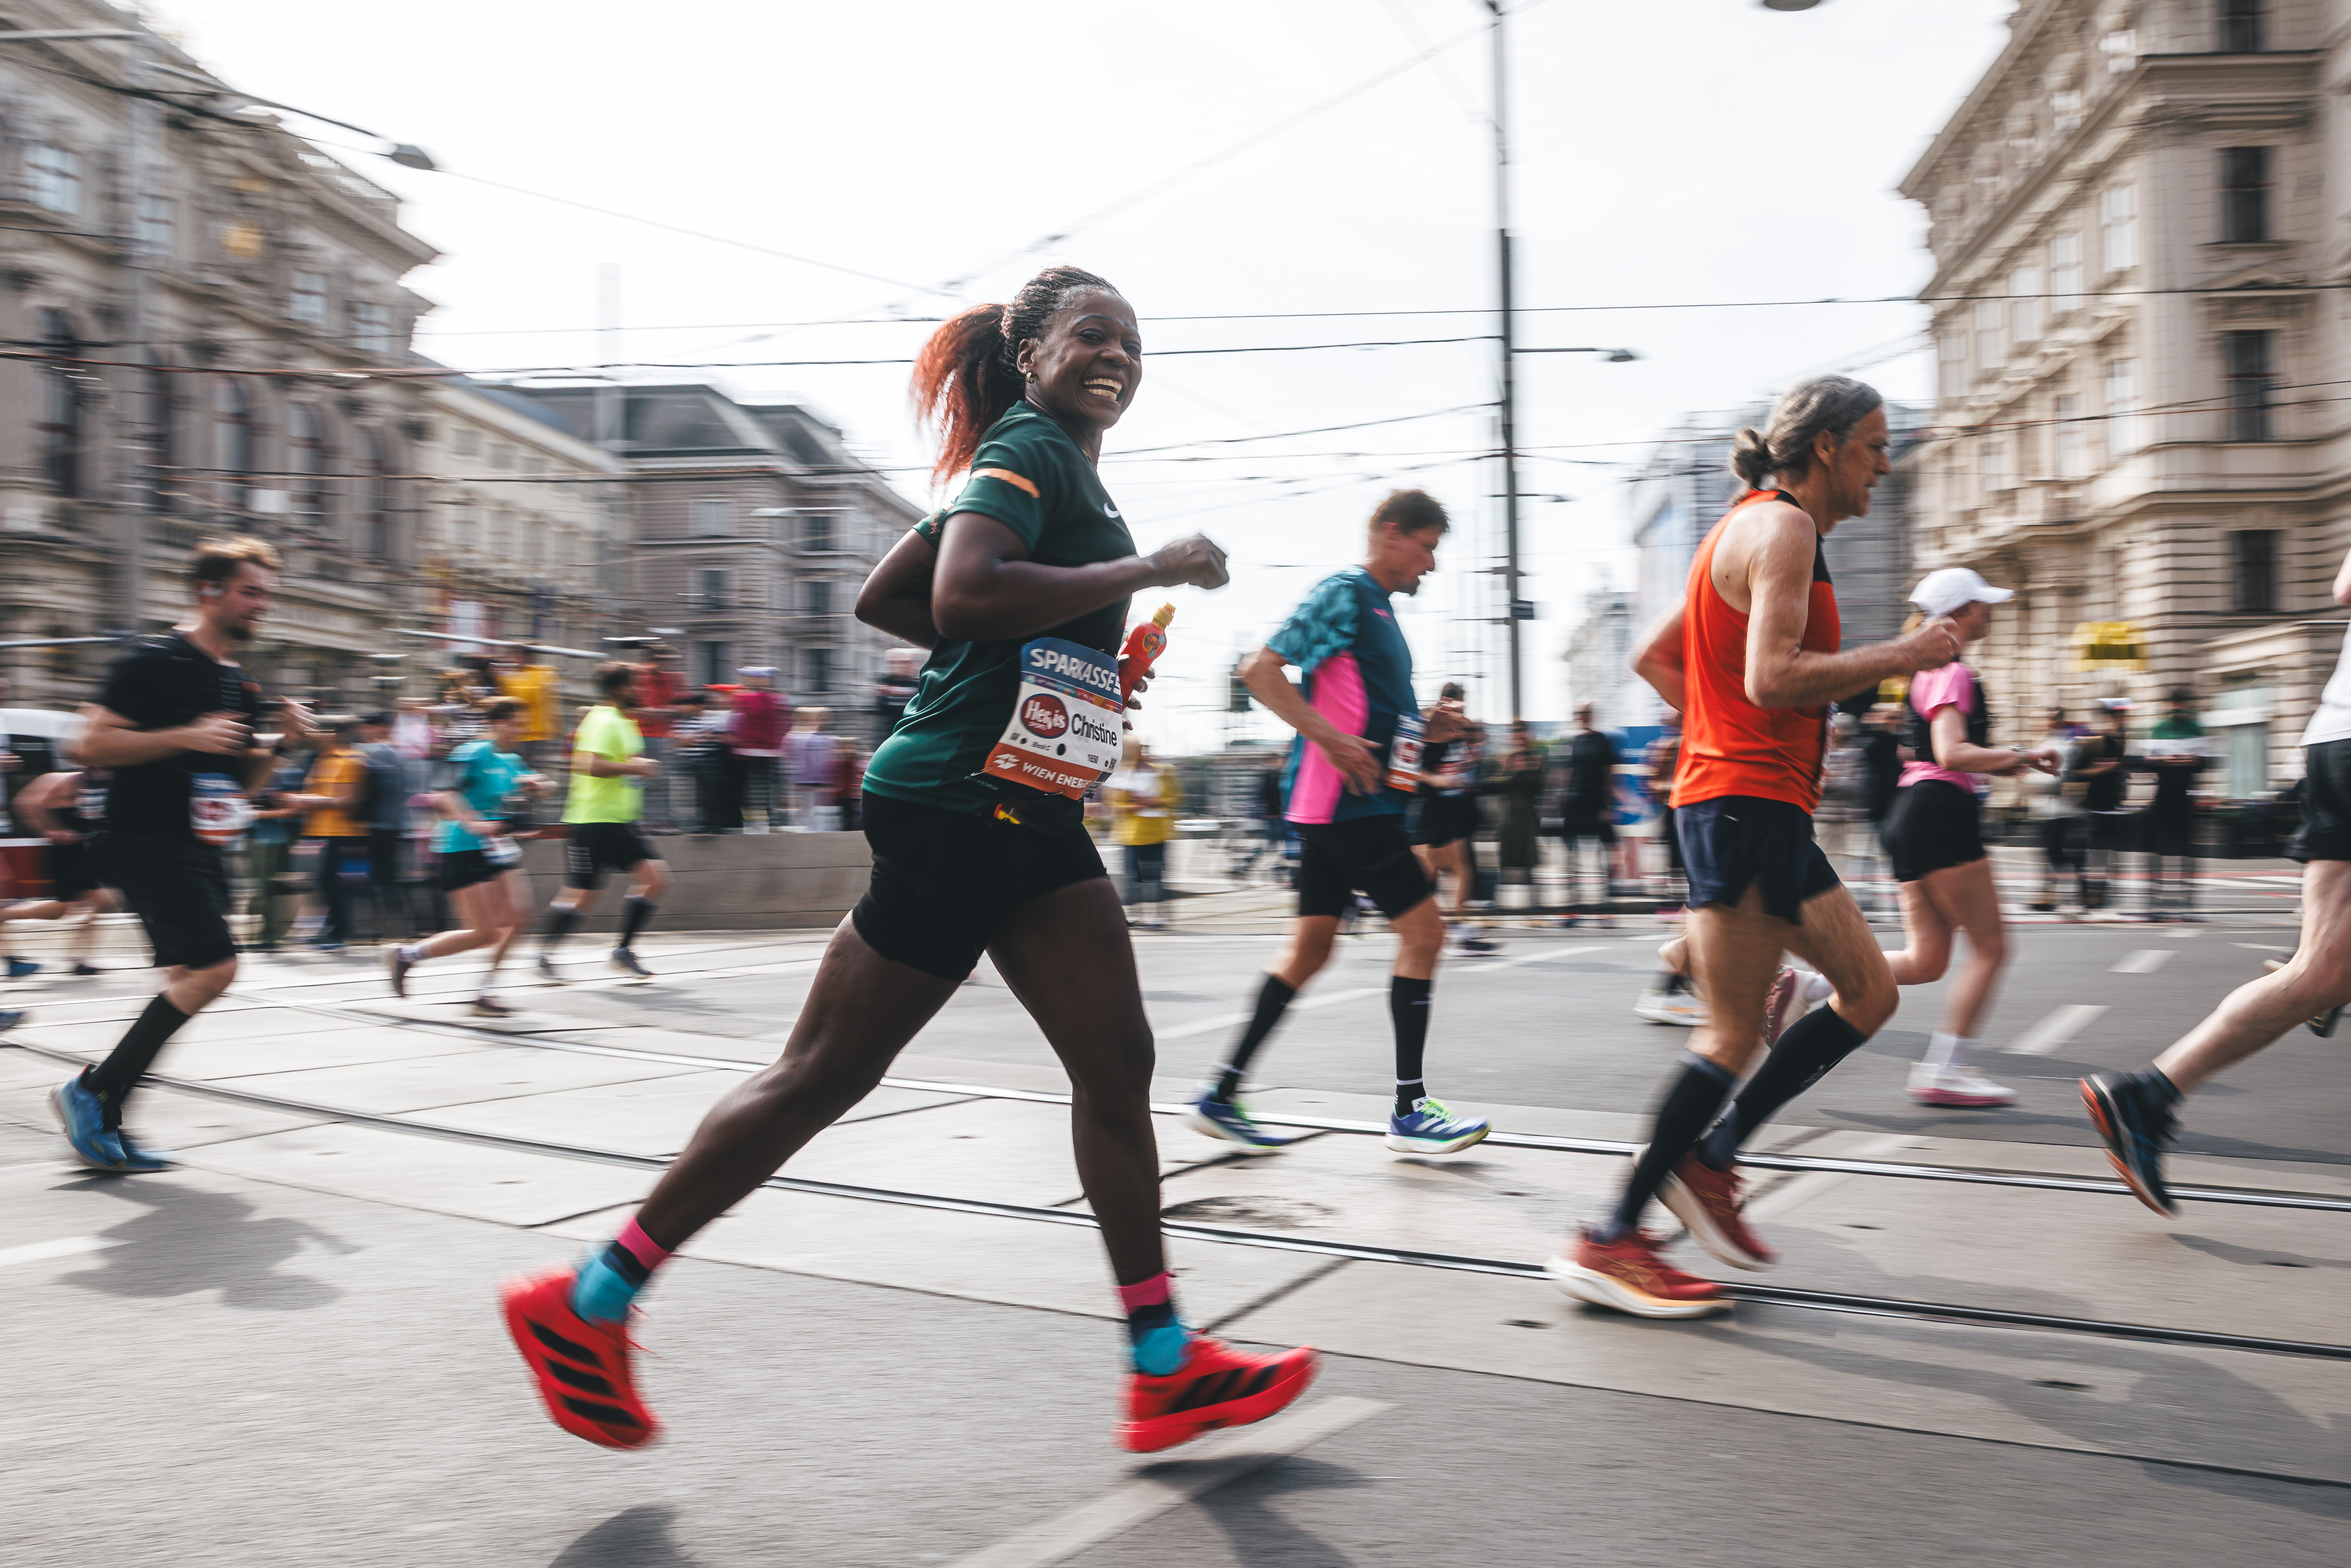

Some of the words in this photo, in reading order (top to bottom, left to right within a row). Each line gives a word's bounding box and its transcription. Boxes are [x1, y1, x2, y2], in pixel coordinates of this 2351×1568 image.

[1024, 700, 1066, 729] Hervis
[1071, 713, 1117, 746] Christine
[1022, 762, 1057, 782] WIEN
[1056, 773, 1092, 789] ENERGIE
